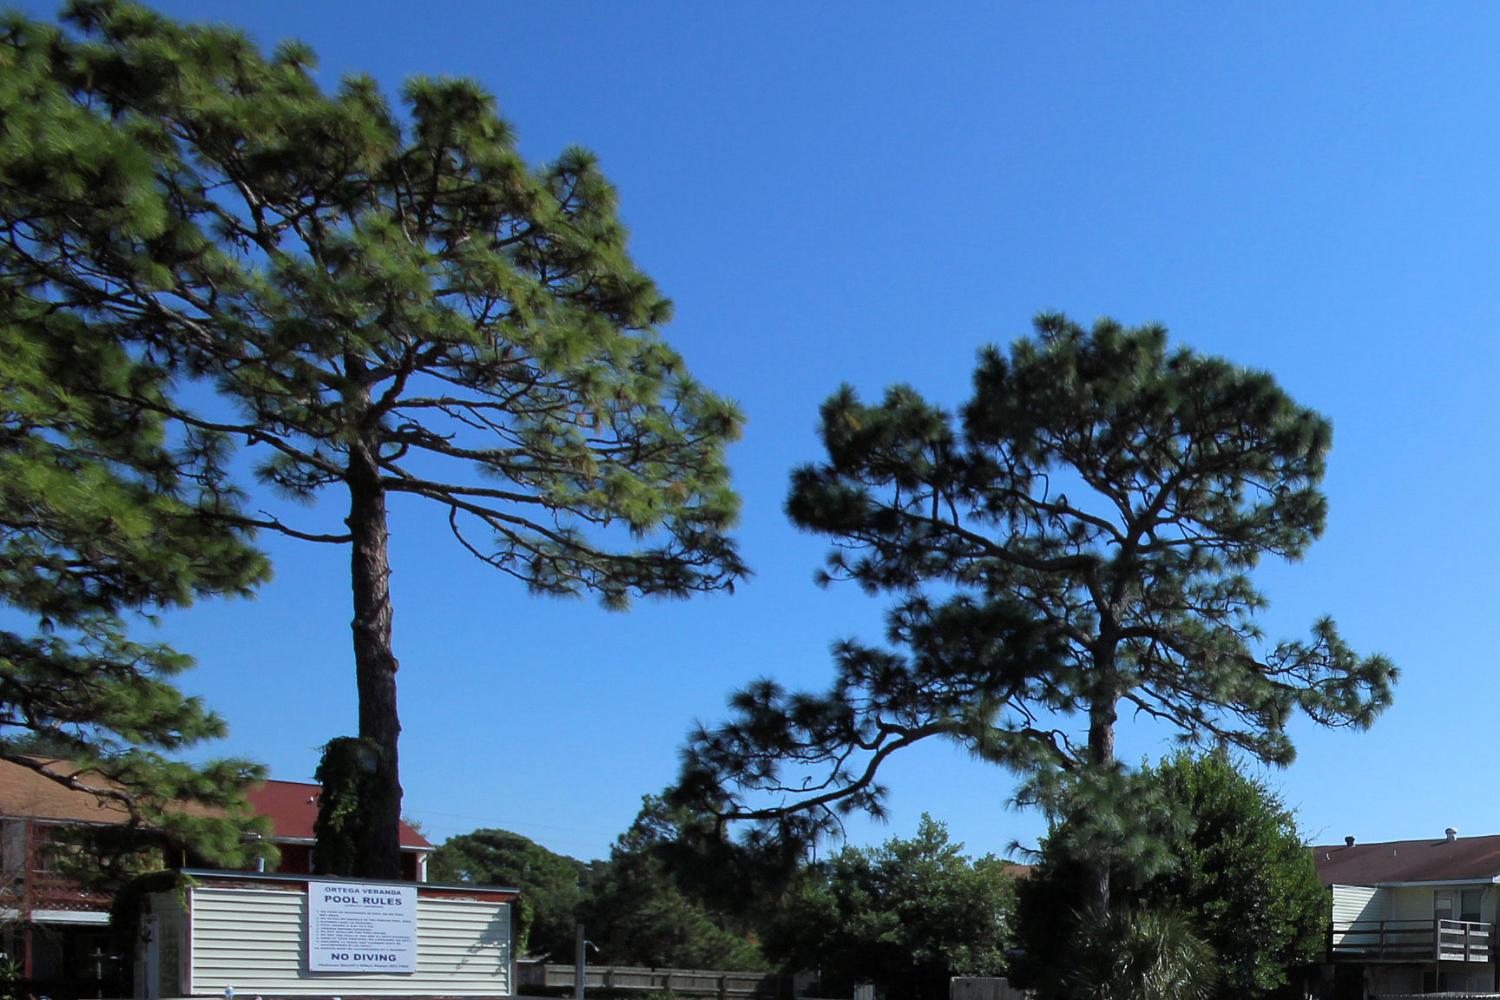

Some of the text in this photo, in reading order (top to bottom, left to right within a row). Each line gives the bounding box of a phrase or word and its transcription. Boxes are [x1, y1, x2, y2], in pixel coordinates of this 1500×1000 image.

[324, 895, 359, 904] POOL
[362, 897, 402, 906] RULES
[331, 953, 397, 962] NO DIVING
